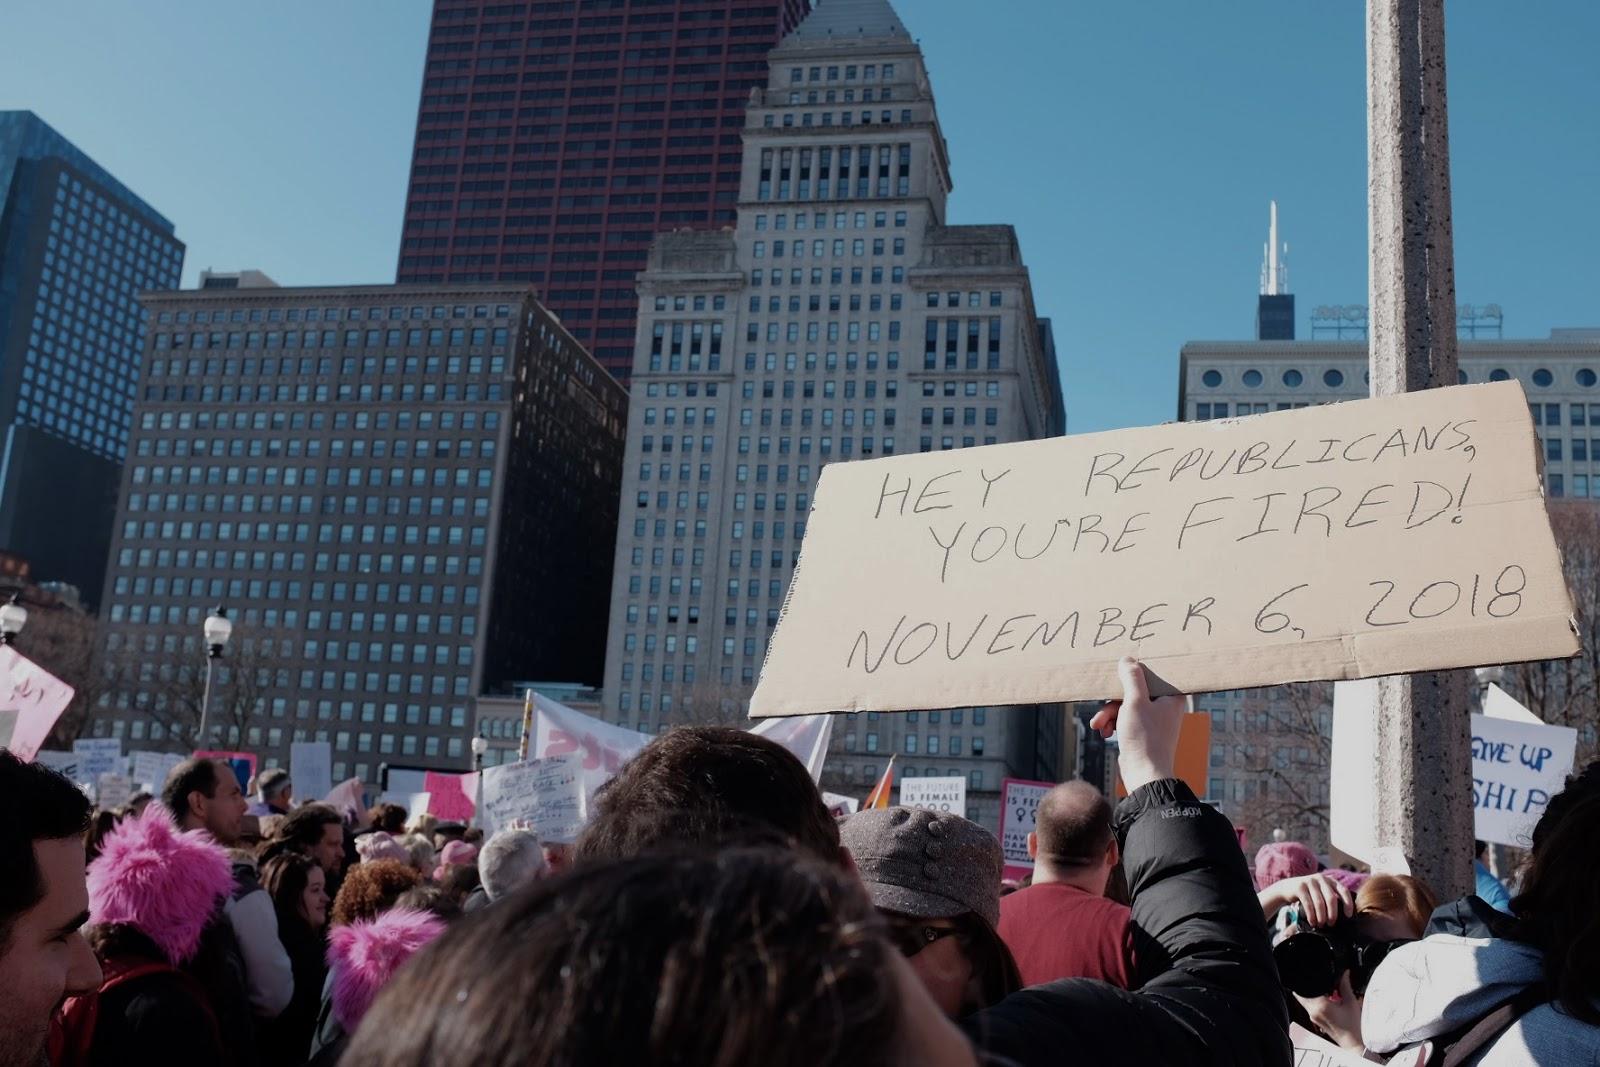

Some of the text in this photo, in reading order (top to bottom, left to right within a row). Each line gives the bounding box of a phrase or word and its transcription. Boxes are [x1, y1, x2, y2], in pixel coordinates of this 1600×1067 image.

[874, 419, 1478, 519] HEY REPUBLICANS,
[928, 472, 1472, 583] YOU'RE FIRED!
[847, 564, 1527, 674] NOVEMBER 6, 2018
[1519, 744, 1553, 772] UP
[905, 792, 960, 801] IS FEMALE
[907, 782, 960, 792] THE FUTURE
[1008, 785, 1025, 796] THE
[1007, 796, 1018, 806] IS
